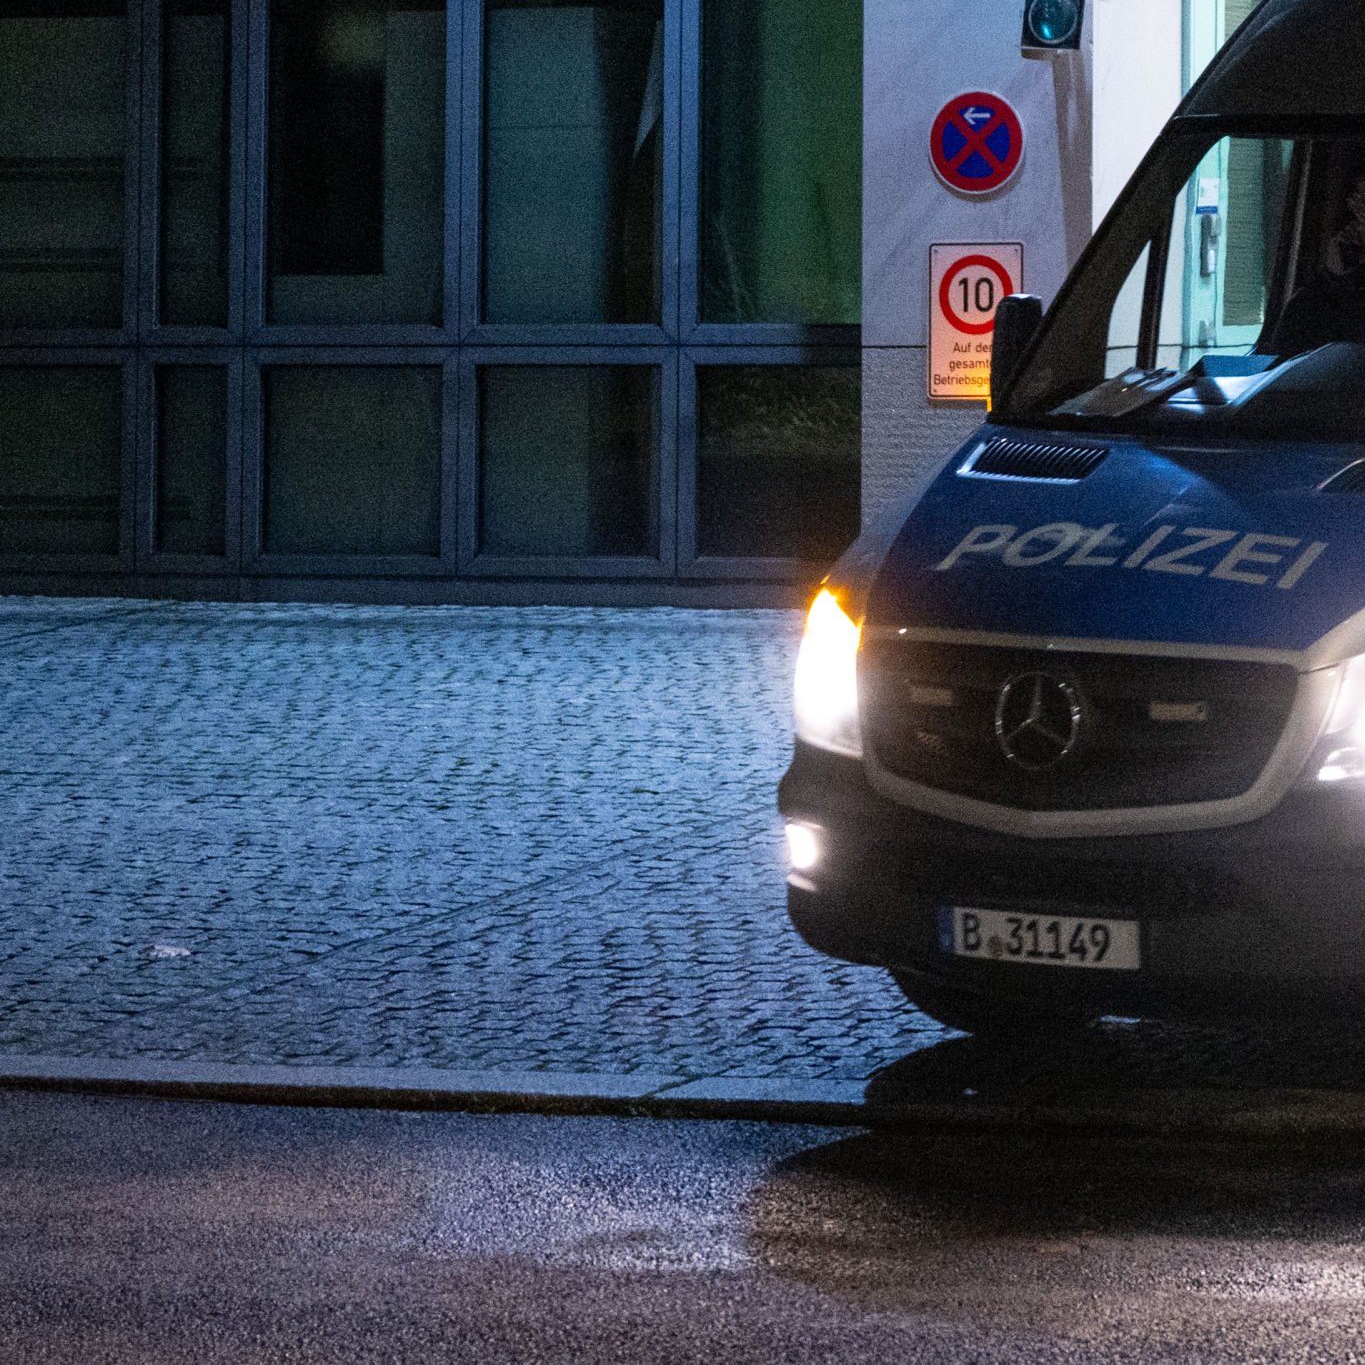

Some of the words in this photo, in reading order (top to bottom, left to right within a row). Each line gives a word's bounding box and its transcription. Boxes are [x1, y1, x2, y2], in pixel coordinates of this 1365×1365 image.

[958, 277, 994, 313] 10
[952, 341, 972, 353] Auf
[933, 373, 990, 387] Betriebsge
[935, 522, 1330, 590] POLIZEI
[961, 912, 980, 951] B
[1005, 917, 1110, 962] 31149
